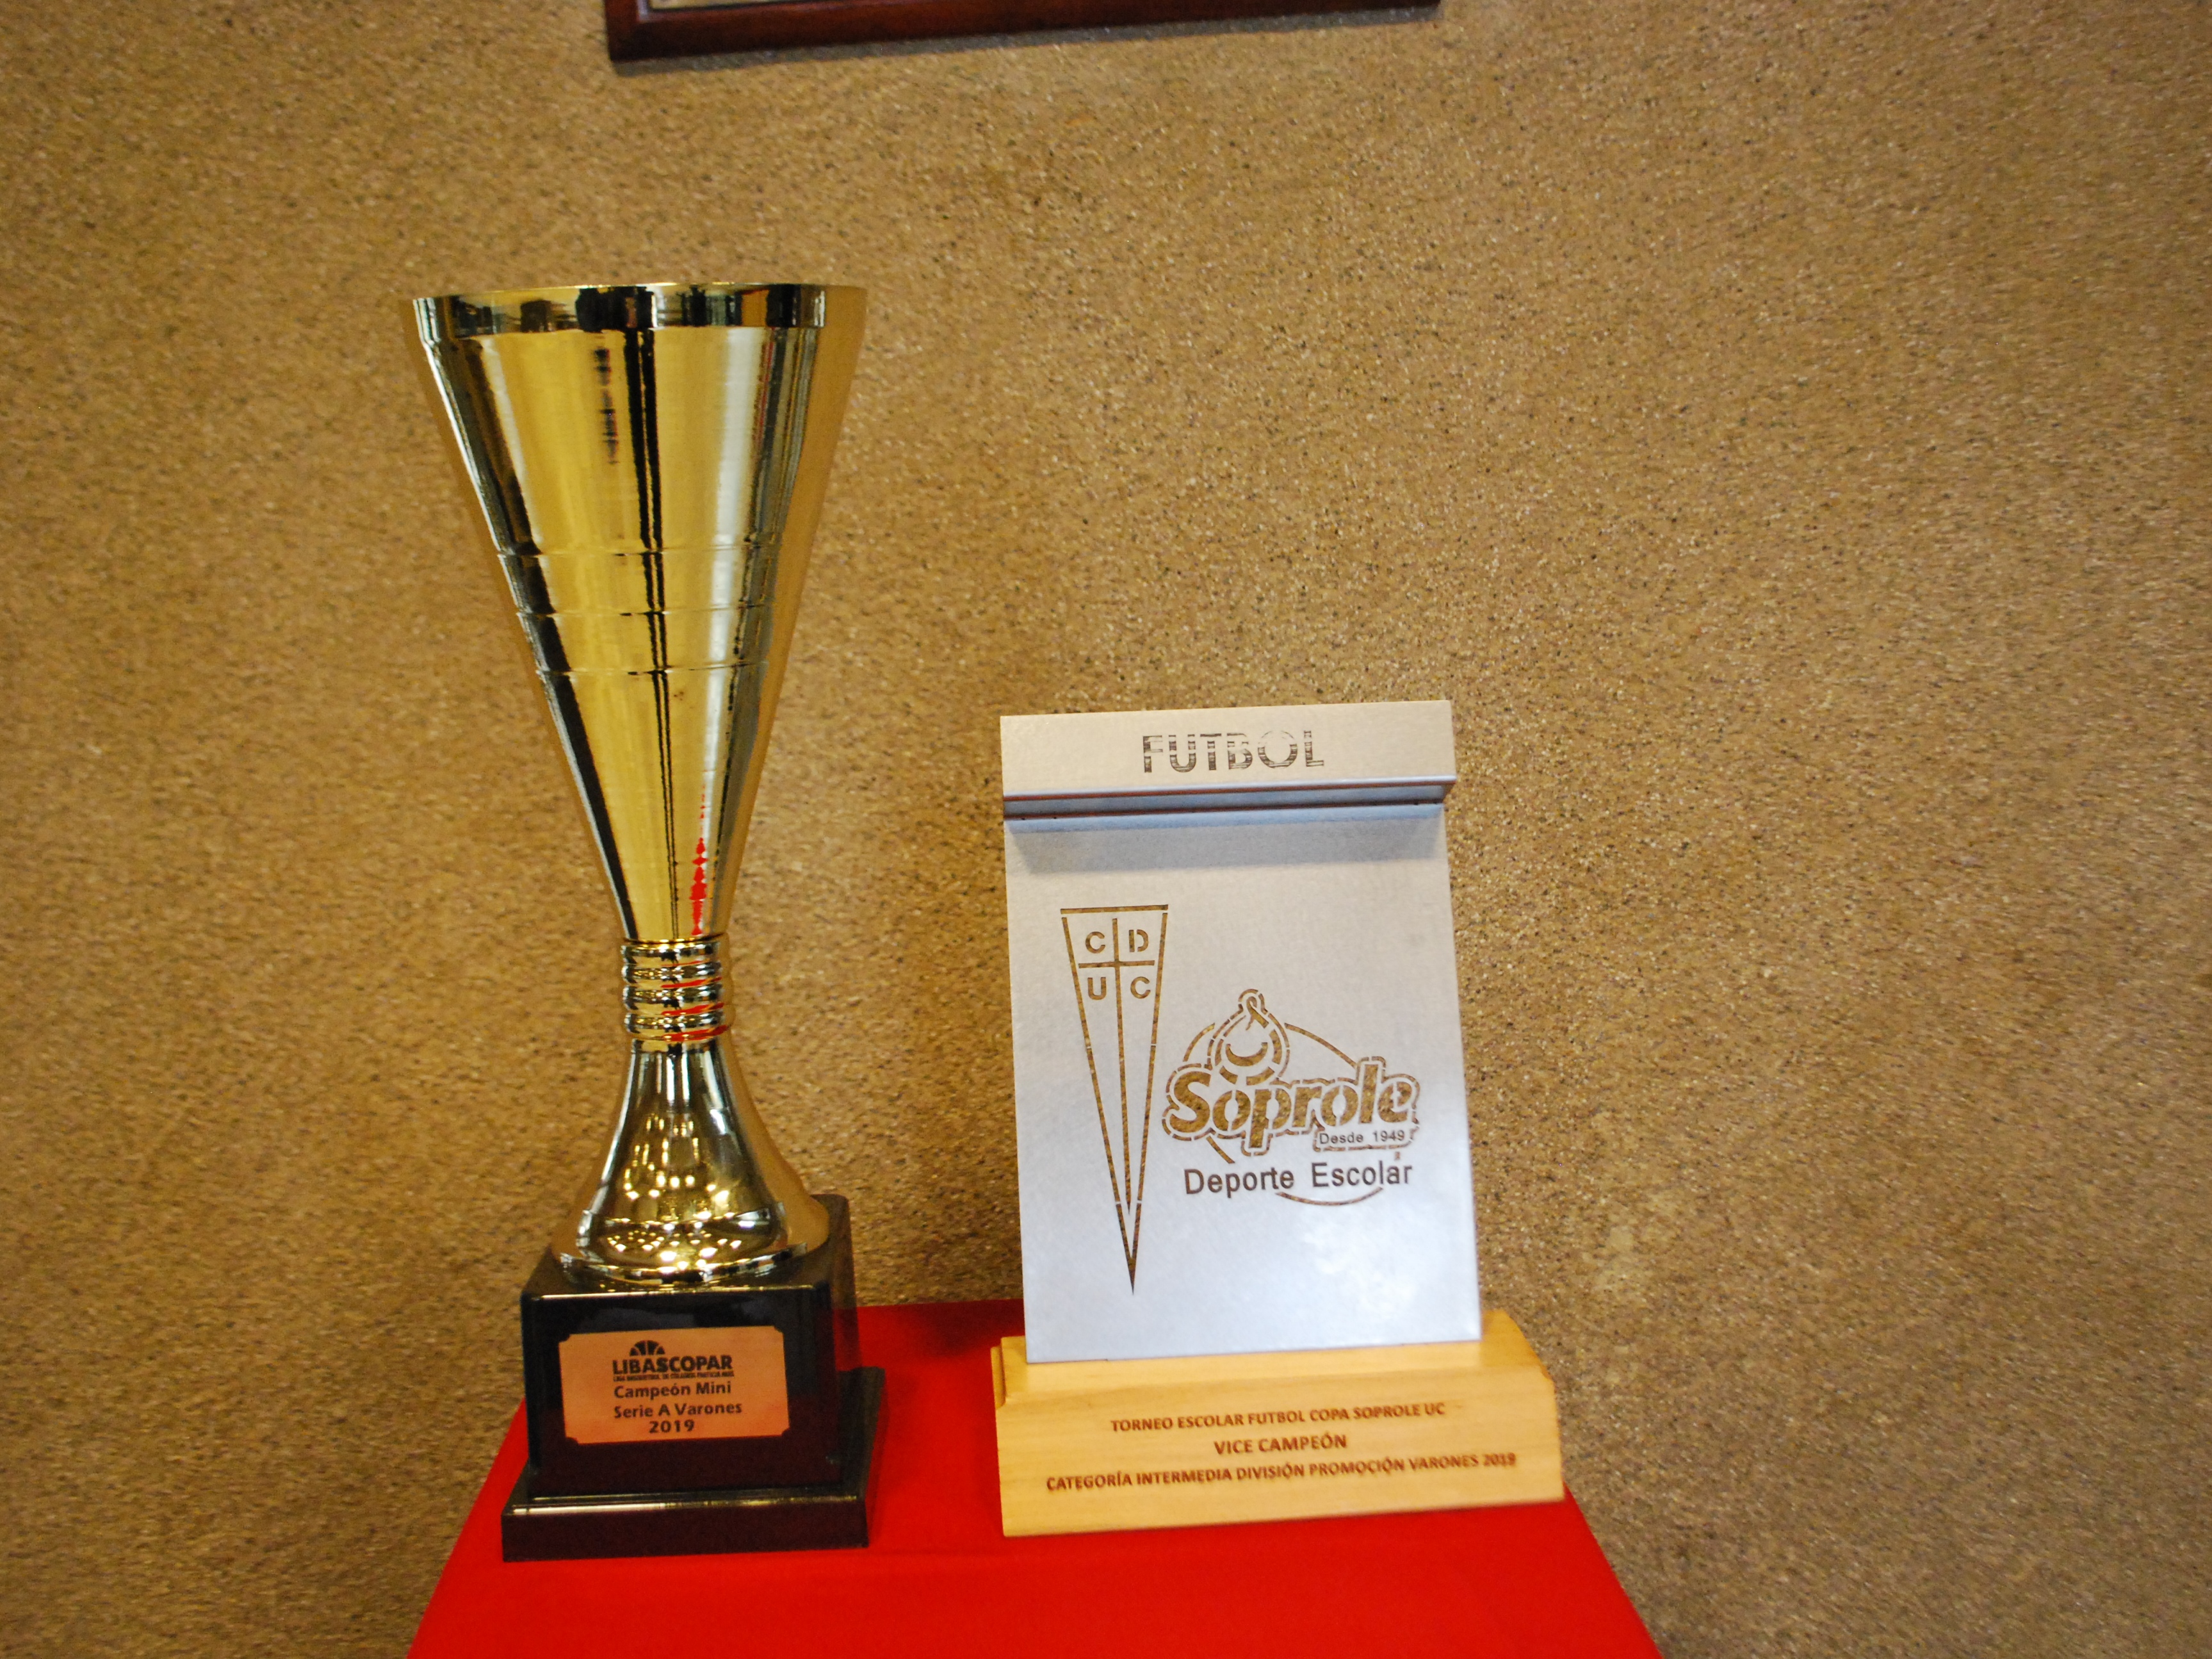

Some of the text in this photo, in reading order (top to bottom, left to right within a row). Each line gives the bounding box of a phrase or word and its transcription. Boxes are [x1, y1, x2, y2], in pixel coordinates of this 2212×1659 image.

[1143, 730, 1324, 773] FUTBOL
[1169, 1064, 1413, 1148] Soprole
[1320, 1130, 1405, 1144] Desde 1949
[1184, 1160, 1413, 1198] Deporte Escolar
[612, 1355, 733, 1375] LIBASCOPAR
[614, 1380, 731, 1400] Campeón Mini
[614, 1403, 742, 1419] Serie A Varones
[1111, 1402, 1445, 1432] TORNEO ESCOLAR FUTBOL COPA SOPROLE UC
[649, 1419, 695, 1434] 2019
[1214, 1432, 1347, 1455] VICE CAMPEÓN
[1046, 1471, 1132, 1491] CATEGORÍA
[1137, 1468, 1232, 1485] INTERMEDIA
[1237, 1462, 1305, 1481] DIVISIÓN
[1309, 1456, 1405, 1477] PROMOCIÓN
[1408, 1455, 1479, 1471] VARONES
